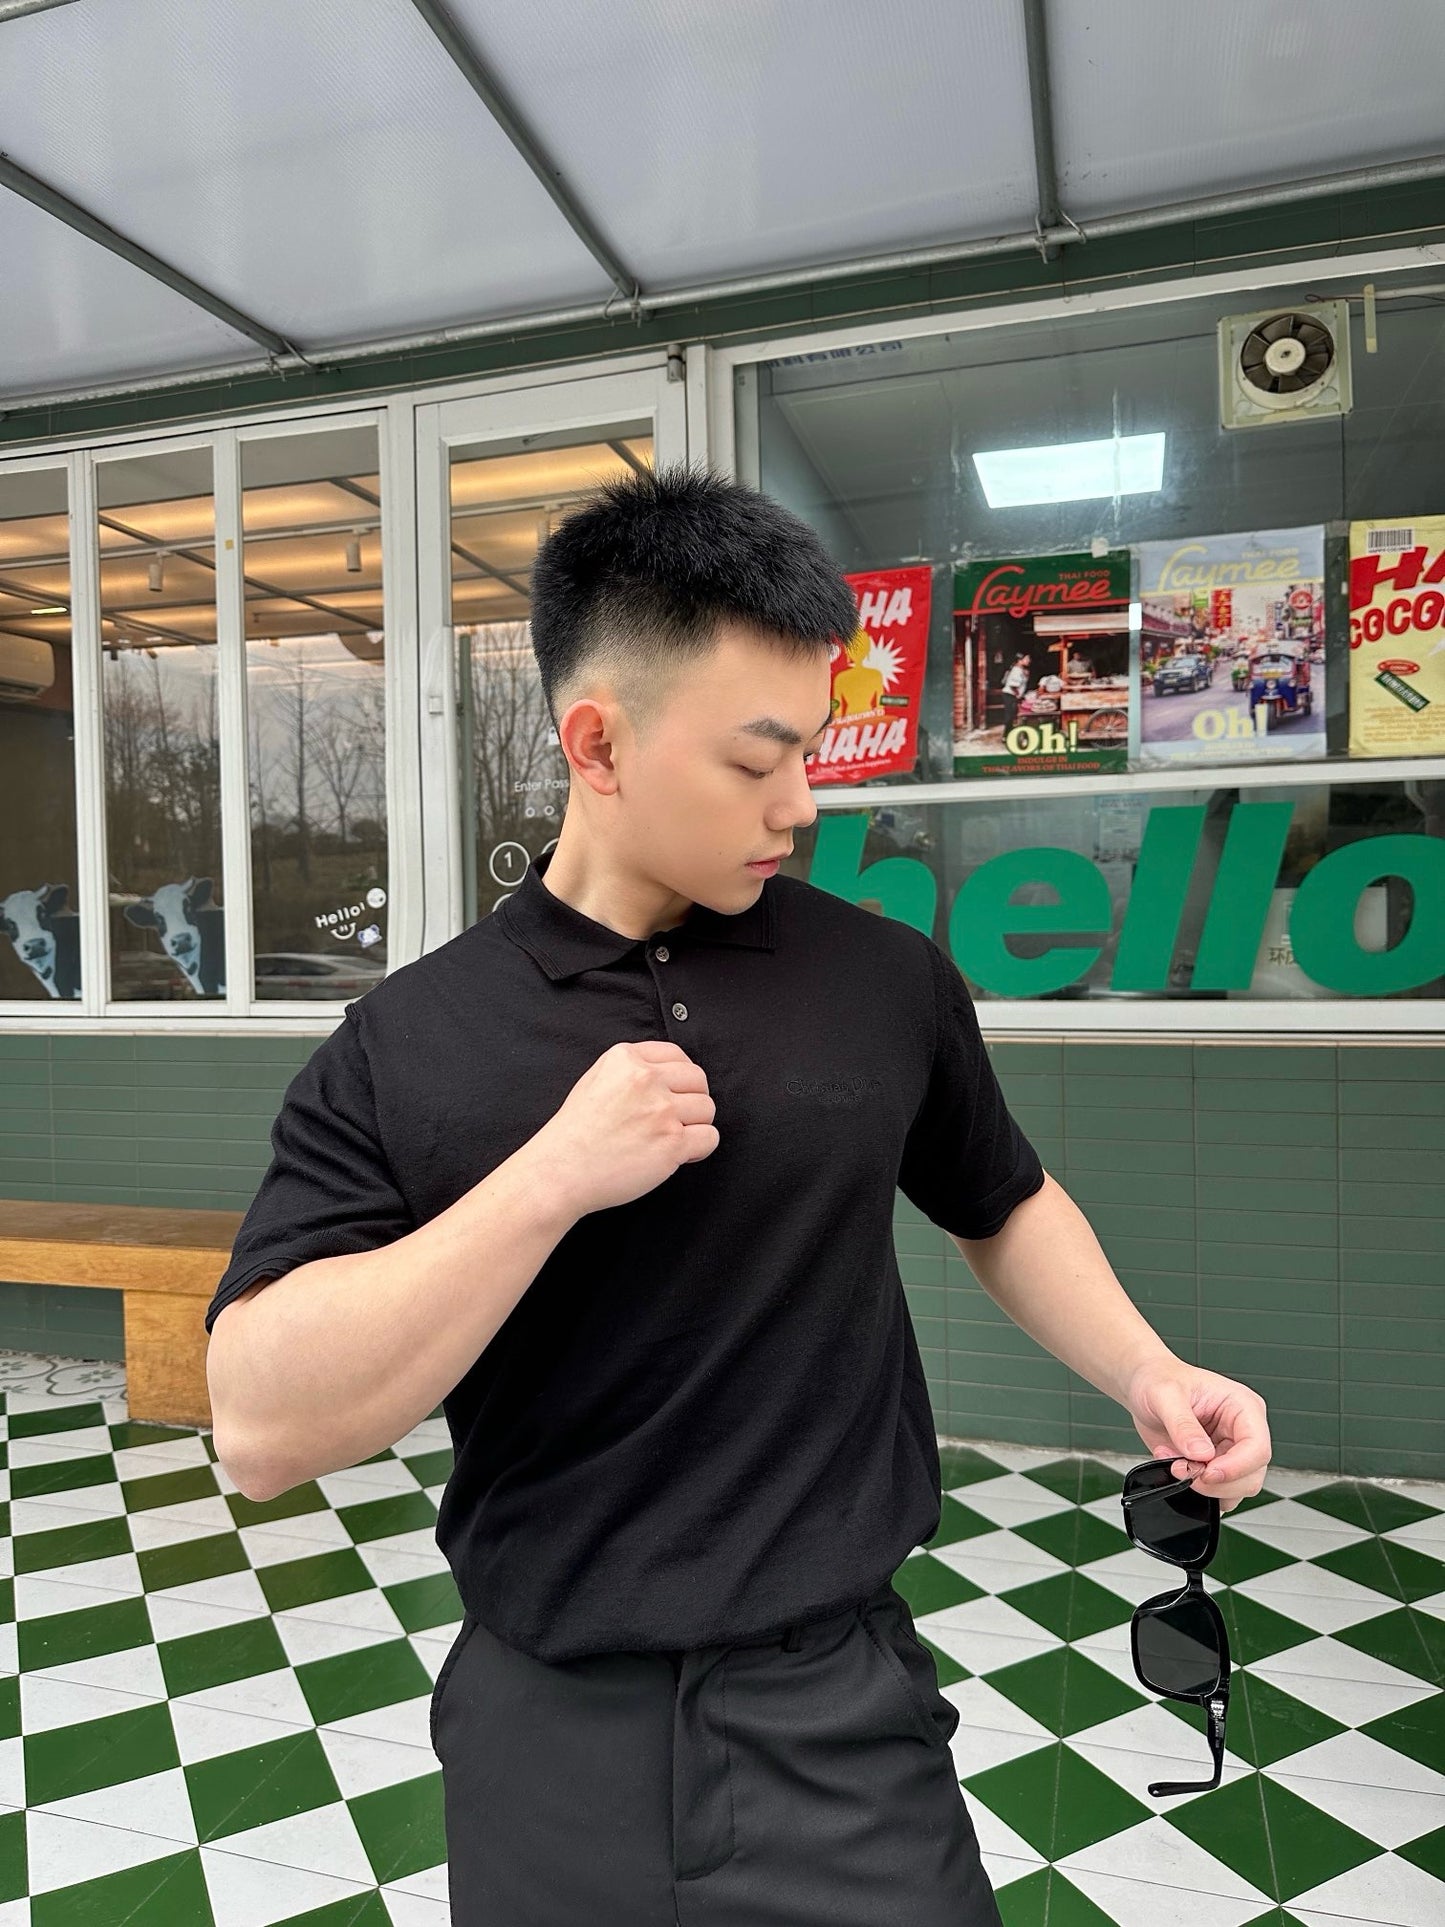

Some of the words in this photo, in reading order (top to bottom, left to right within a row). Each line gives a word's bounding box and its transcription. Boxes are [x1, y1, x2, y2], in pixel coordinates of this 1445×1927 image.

[1058, 571, 1082, 581] THAI
[1083, 569, 1111, 579] FOOD
[1349, 590, 1445, 650] COCO
[1192, 703, 1268, 741] Oh!
[1005, 720, 1079, 756] Oh!
[1056, 763, 1076, 771] THAI
[1077, 762, 1100, 770] FOOD
[514, 779, 542, 793] Enter
[544, 778, 570, 791] Pass
[504, 851, 513, 869] 1
[808, 801, 1445, 997] hello
